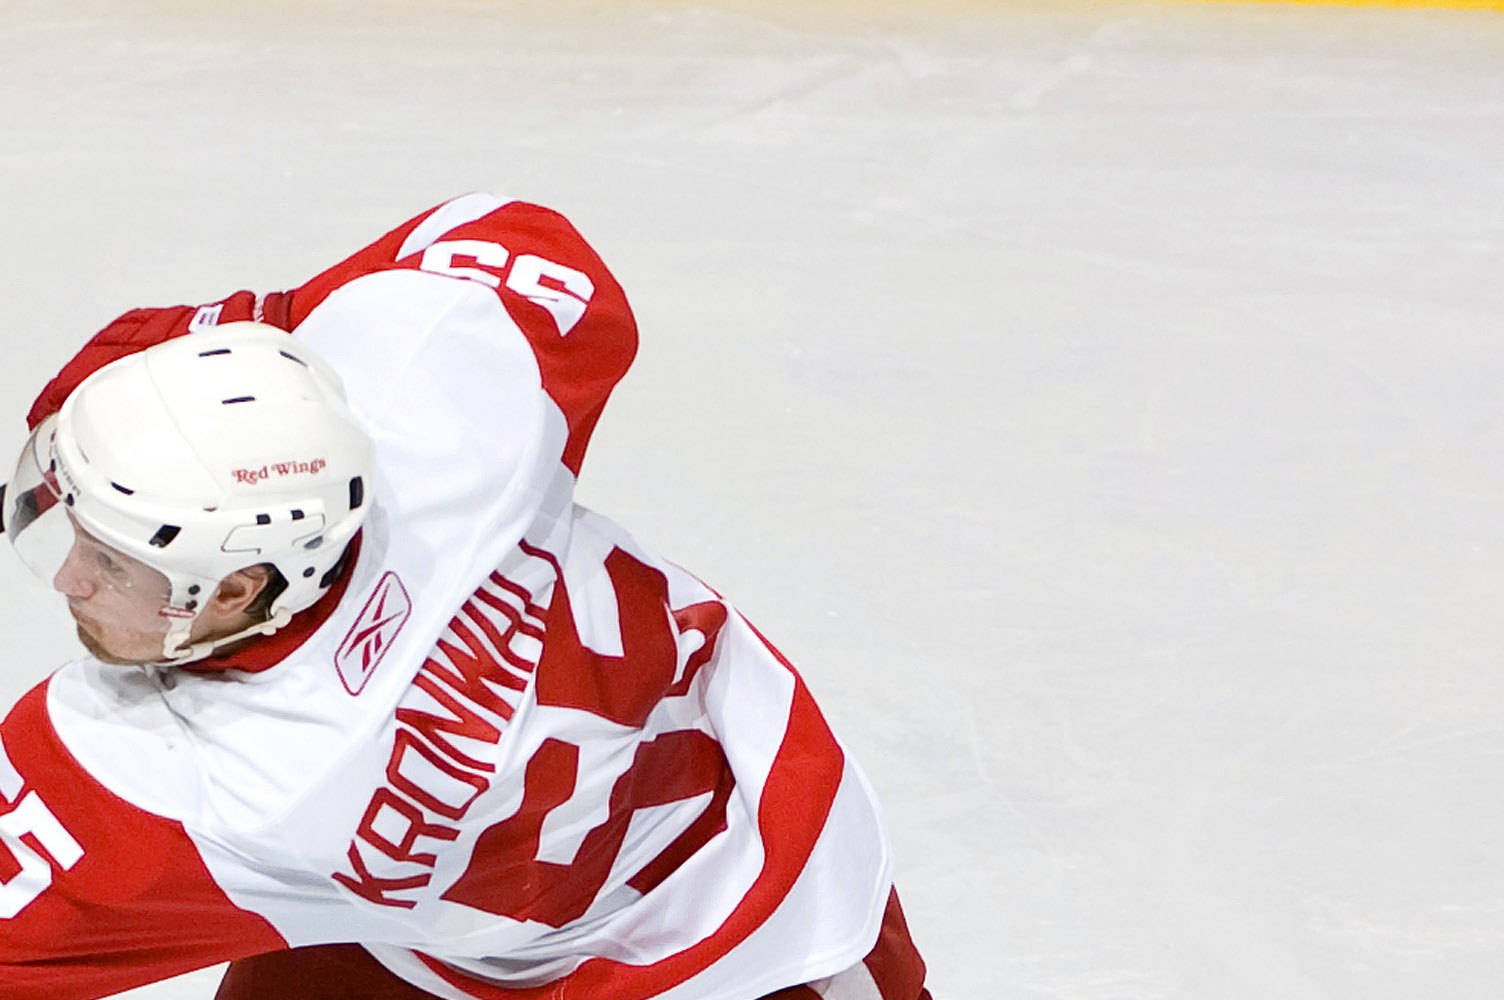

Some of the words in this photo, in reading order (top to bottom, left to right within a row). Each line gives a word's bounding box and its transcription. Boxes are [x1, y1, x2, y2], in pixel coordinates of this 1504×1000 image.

[231, 465, 268, 485] Red
[270, 458, 326, 475] Wings
[440, 544, 736, 928] 55
